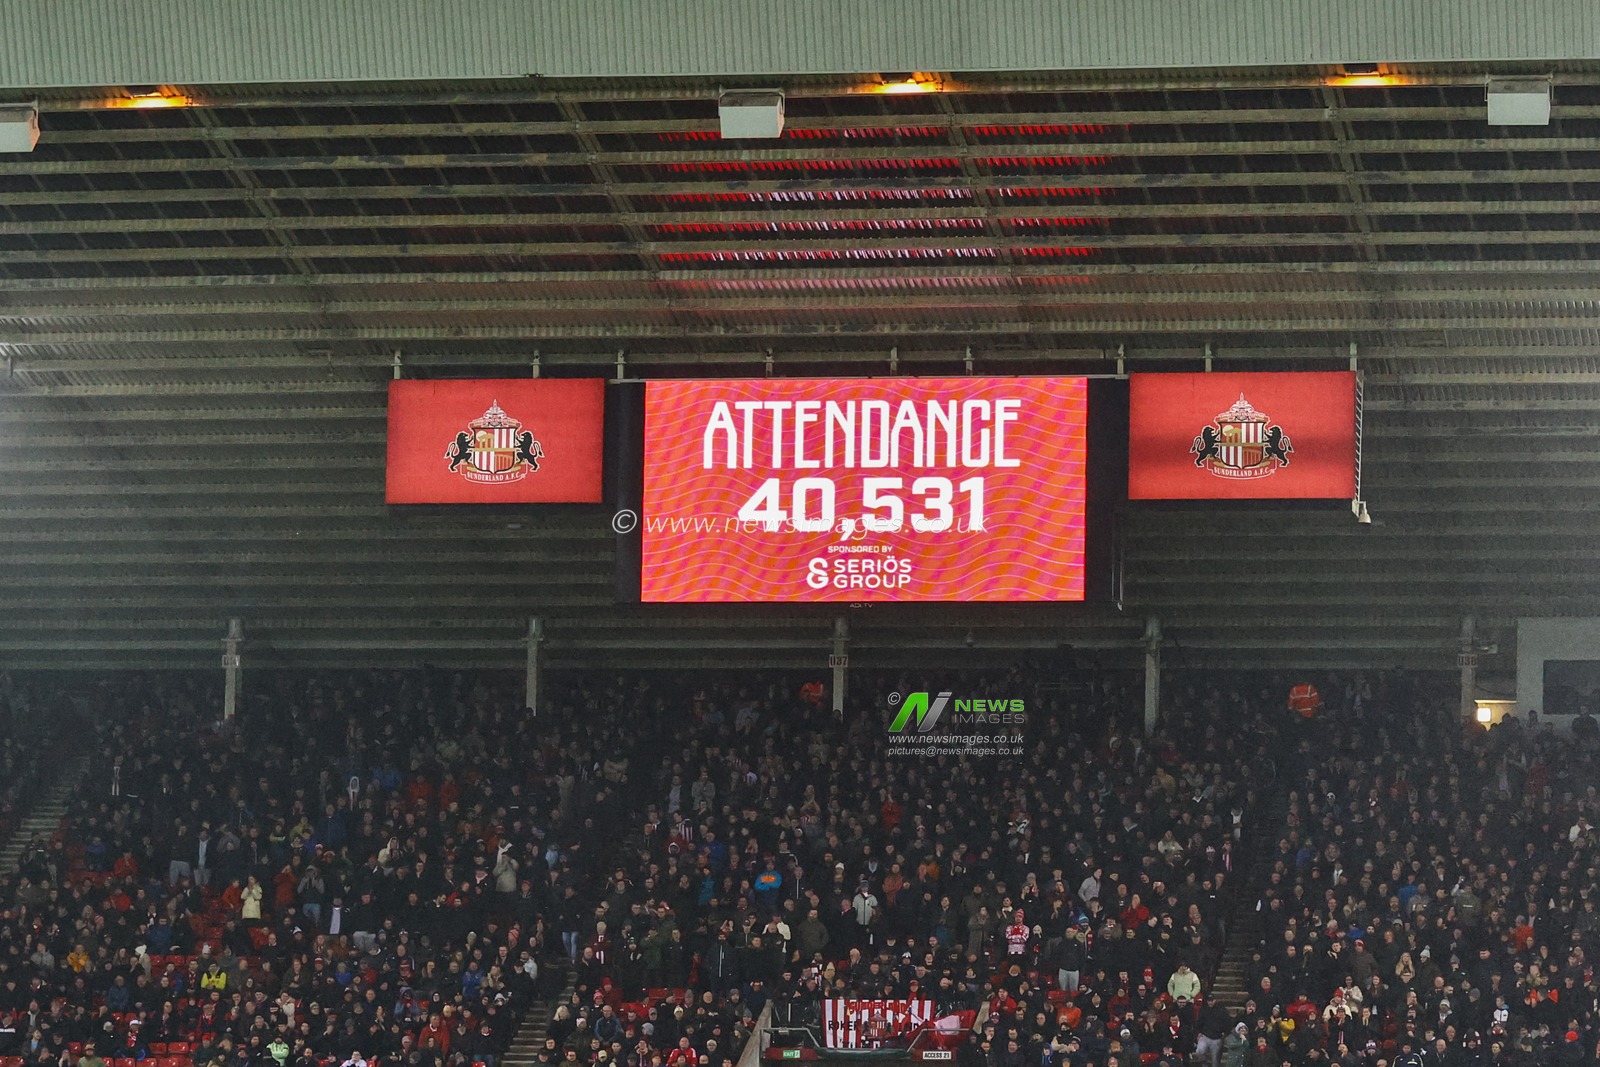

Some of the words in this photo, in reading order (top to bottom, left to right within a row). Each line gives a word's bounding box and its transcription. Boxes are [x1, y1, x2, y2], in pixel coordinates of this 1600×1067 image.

[703, 399, 1022, 469] ATTENDANCE
[467, 472, 503, 481] SUNDERLAND
[1214, 466, 1252, 476] SUNDERLAND
[737, 476, 985, 540] 40,531
[828, 545, 880, 553] SPONSORED
[881, 545, 893, 553] BY
[834, 555, 912, 573] SERIÖS
[833, 574, 911, 588] GROUP
